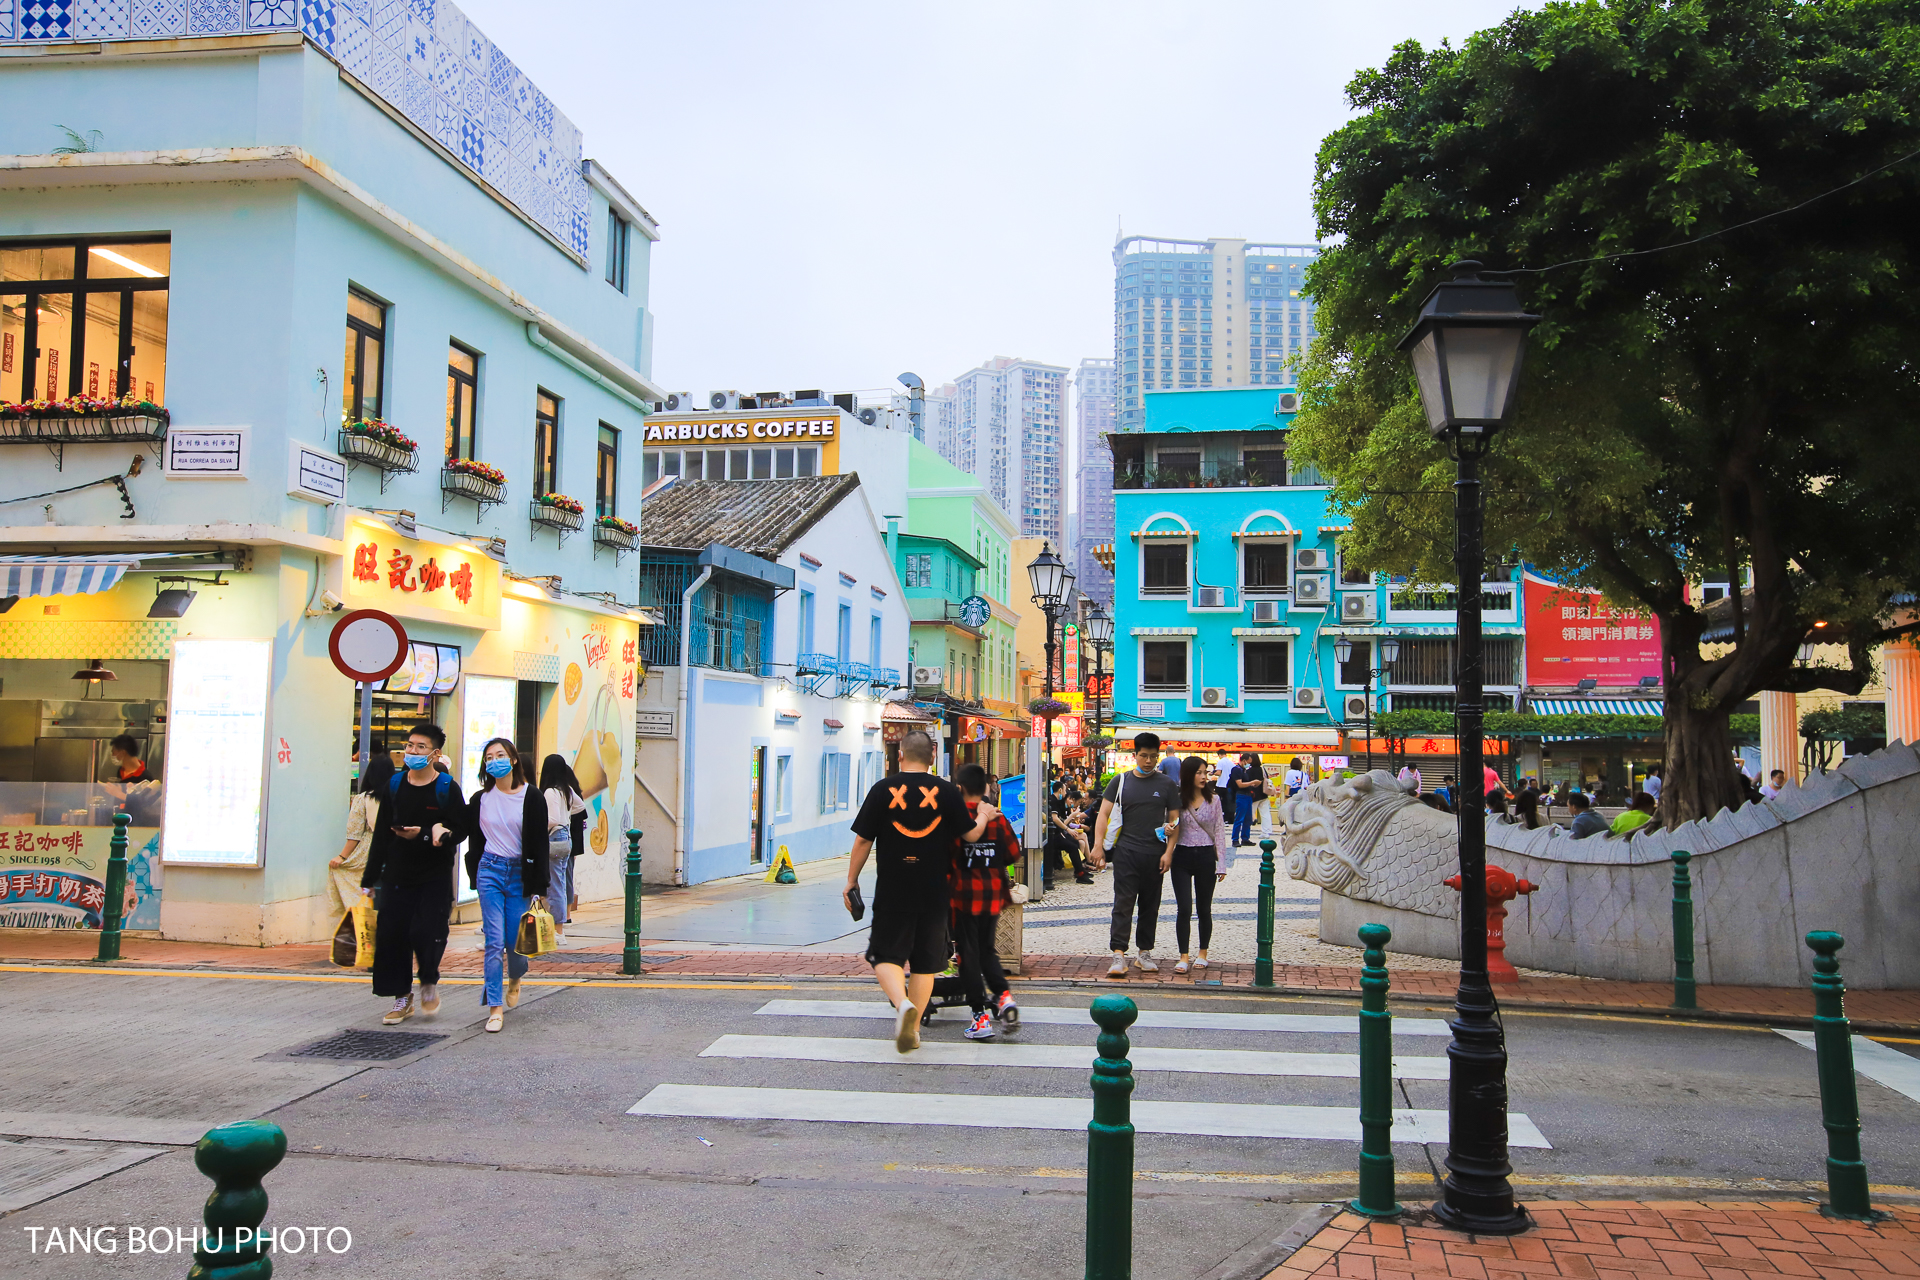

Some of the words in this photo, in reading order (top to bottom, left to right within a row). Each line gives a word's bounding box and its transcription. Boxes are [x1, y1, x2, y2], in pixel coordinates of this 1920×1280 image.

[753, 420, 834, 438] COFFEE
[353, 542, 473, 605] 旺記咖啡
[1561, 626, 1654, 641] 領澳門消費券
[622, 639, 636, 699] 旺記
[10, 855, 39, 864] SINCE
[40, 856, 61, 866] 1958
